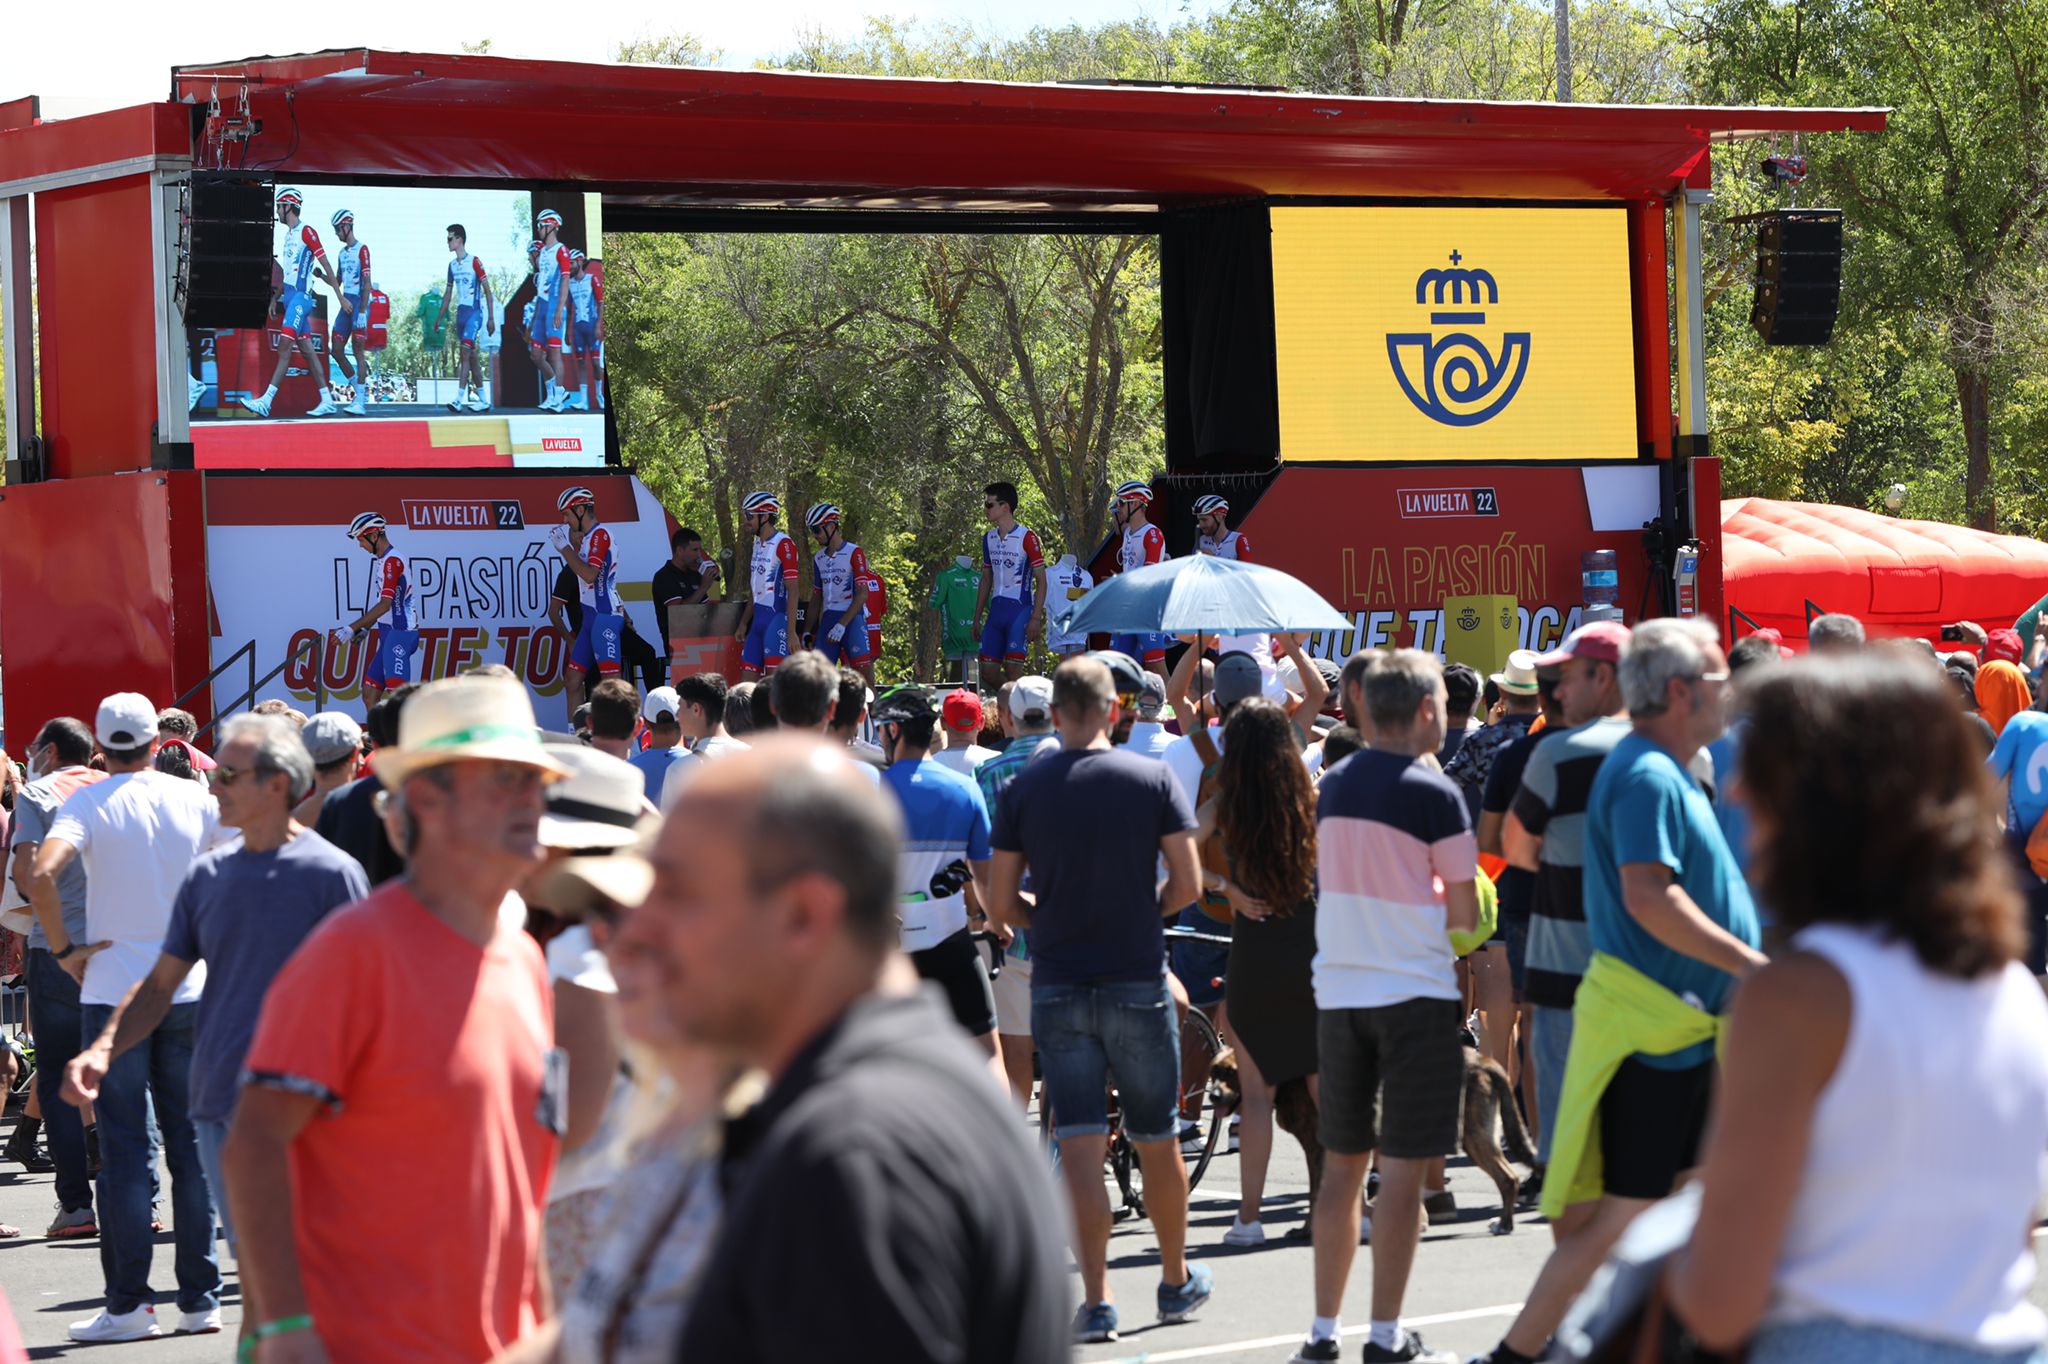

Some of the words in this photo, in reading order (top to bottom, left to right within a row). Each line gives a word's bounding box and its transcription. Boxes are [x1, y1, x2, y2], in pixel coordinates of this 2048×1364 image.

[545, 440, 554, 450] LA
[555, 440, 579, 450] VUELTA
[1406, 494, 1422, 513] LA
[1423, 493, 1469, 512] VUELTA
[1477, 492, 1493, 511] 22
[412, 506, 432, 526] LA
[433, 506, 489, 526] VUELTA
[499, 506, 518, 526] 22
[1343, 547, 1395, 605] LA
[1403, 531, 1546, 604] PASIÓN
[334, 557, 388, 619] L
[283, 627, 390, 694] QU
[498, 625, 573, 687] TO
[607, 642, 616, 659] FDJ
[394, 657, 404, 675] FDJ
